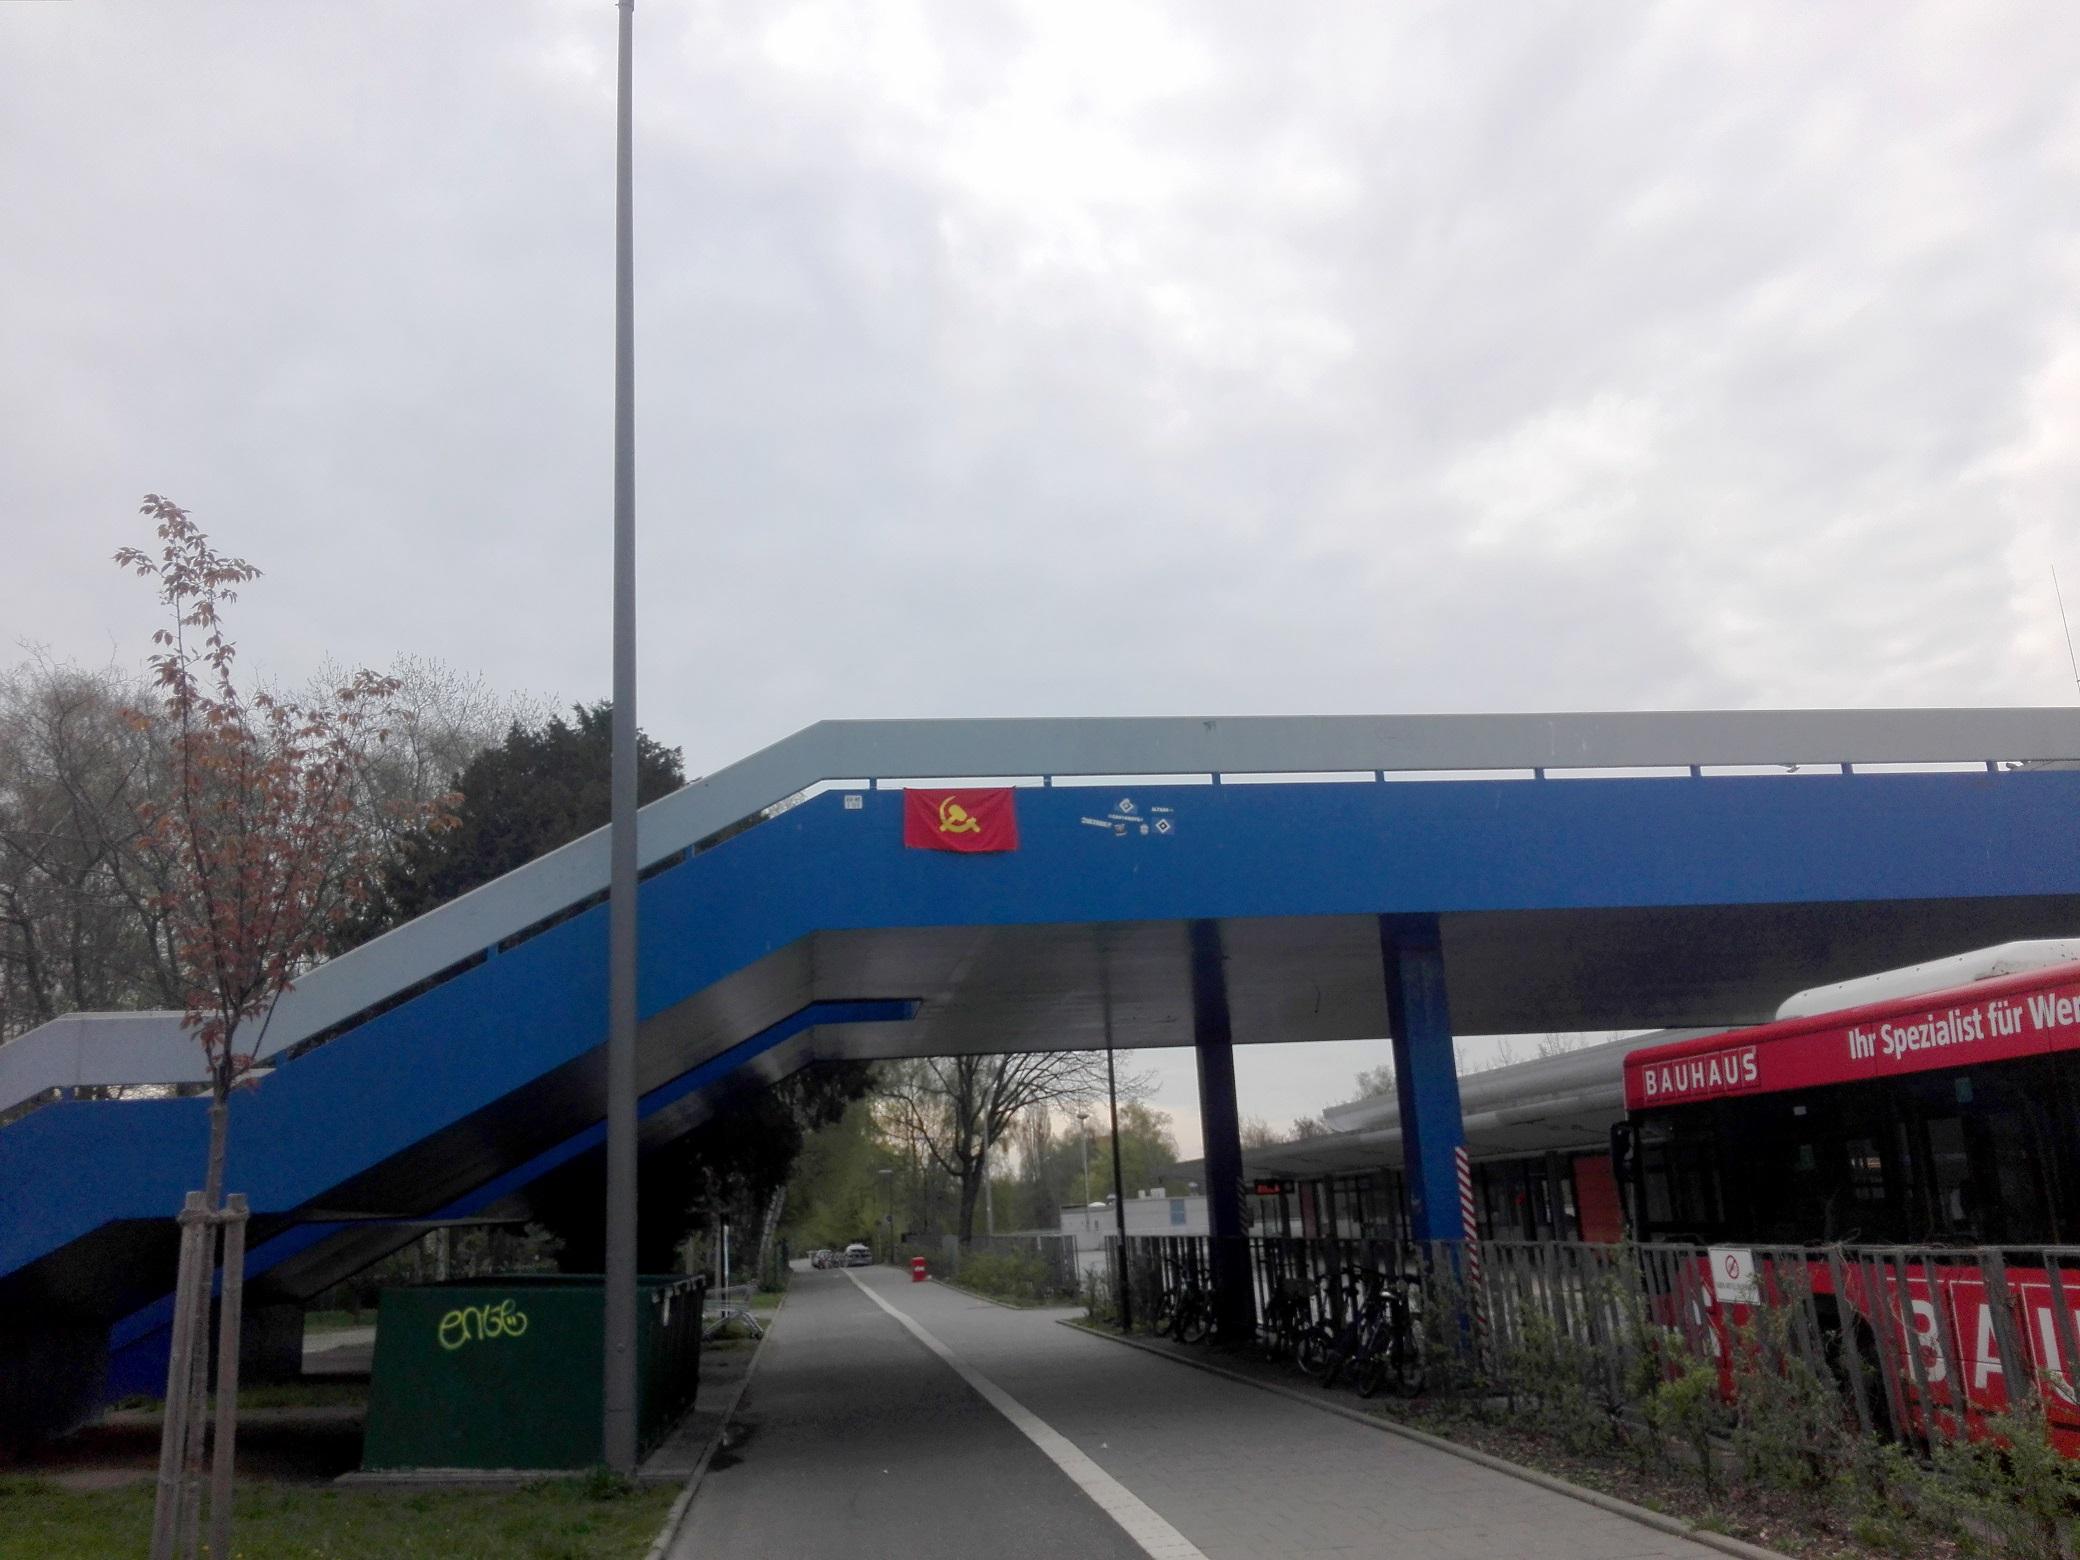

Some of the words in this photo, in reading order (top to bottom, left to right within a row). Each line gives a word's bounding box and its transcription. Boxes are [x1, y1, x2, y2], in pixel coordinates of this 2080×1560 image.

[1848, 1027, 1876, 1060] Ihr
[1880, 1007, 1985, 1061] Spezialist
[1988, 1000, 2023, 1038] für
[1645, 1052, 1758, 1095] BAUHAUS
